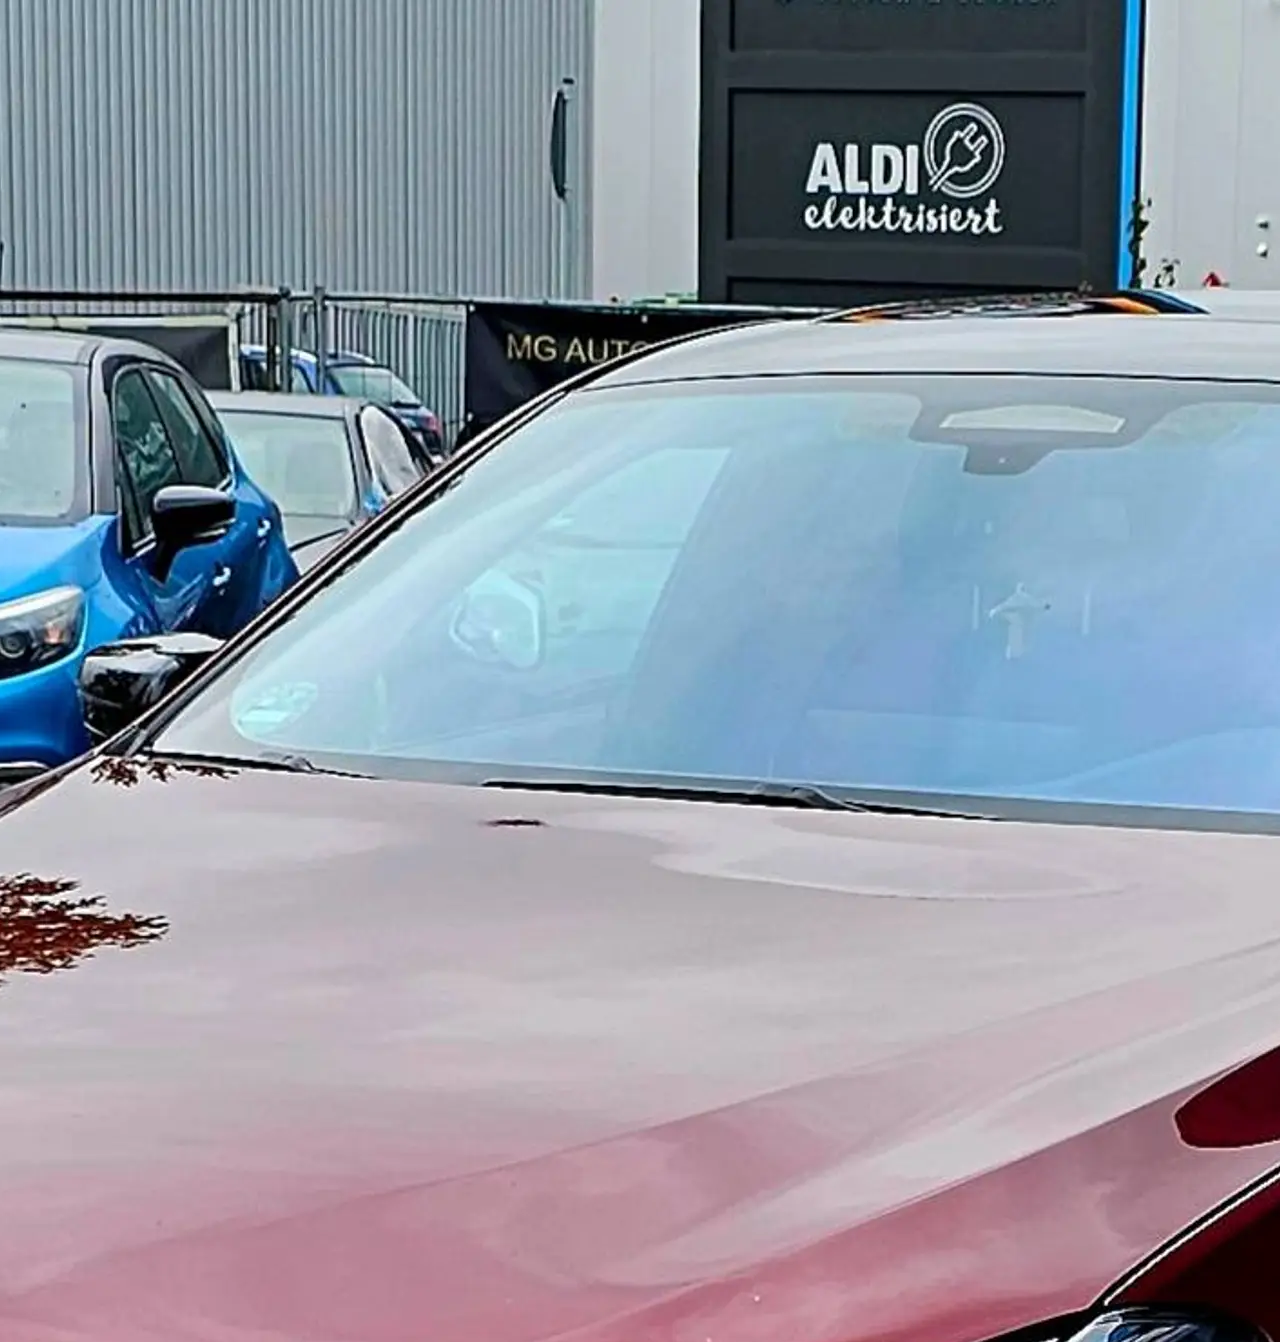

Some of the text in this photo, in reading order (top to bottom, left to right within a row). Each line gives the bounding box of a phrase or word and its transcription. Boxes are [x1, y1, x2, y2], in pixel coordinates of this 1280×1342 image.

[806, 142, 919, 194] ALDI
[804, 196, 1003, 235] elektrisiert
[506, 332, 557, 361] MG
